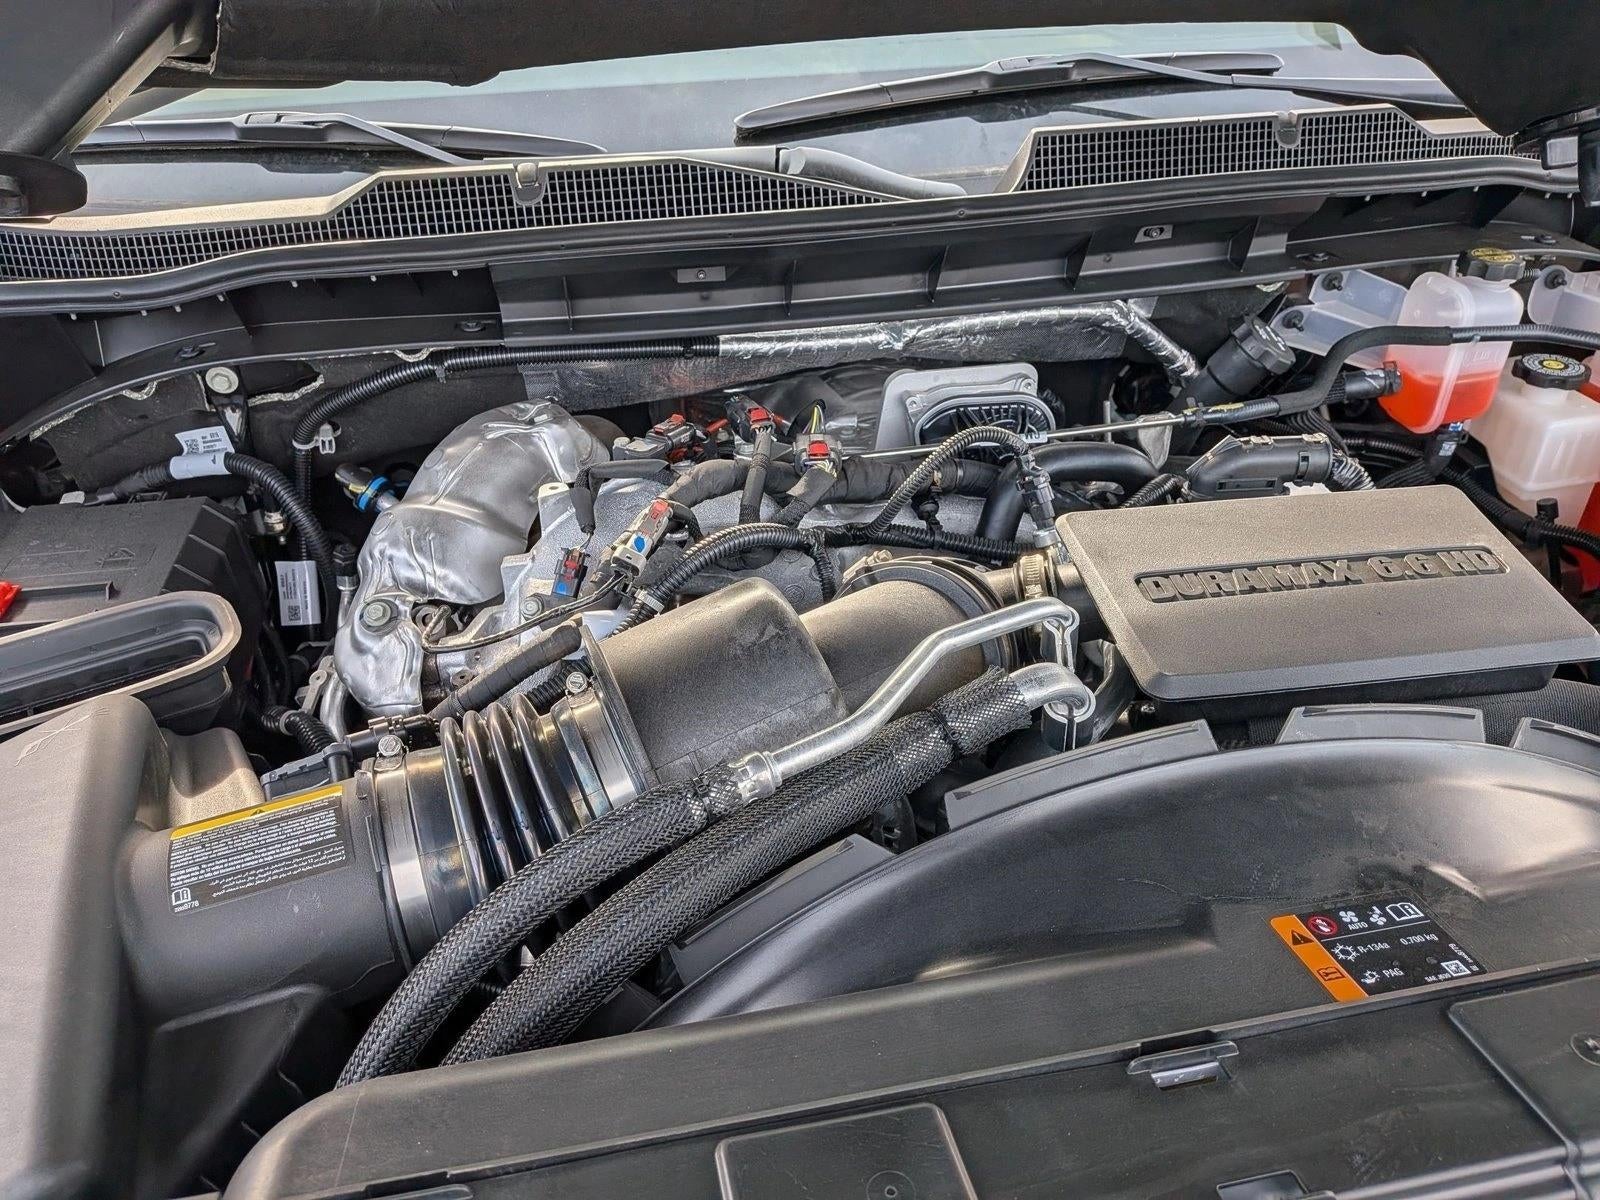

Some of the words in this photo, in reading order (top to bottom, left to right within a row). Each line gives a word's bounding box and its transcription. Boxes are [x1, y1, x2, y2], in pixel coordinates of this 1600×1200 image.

[1139, 559, 1362, 600] DURAMAX
[1367, 553, 1438, 579] 6.6
[1438, 549, 1499, 574] HD
[1348, 921, 1368, 930] AUTO
[1357, 942, 1390, 953] R-134a
[1400, 934, 1425, 945] 0.700
[1425, 933, 1439, 942] kg
[1382, 967, 1405, 978] PAG
